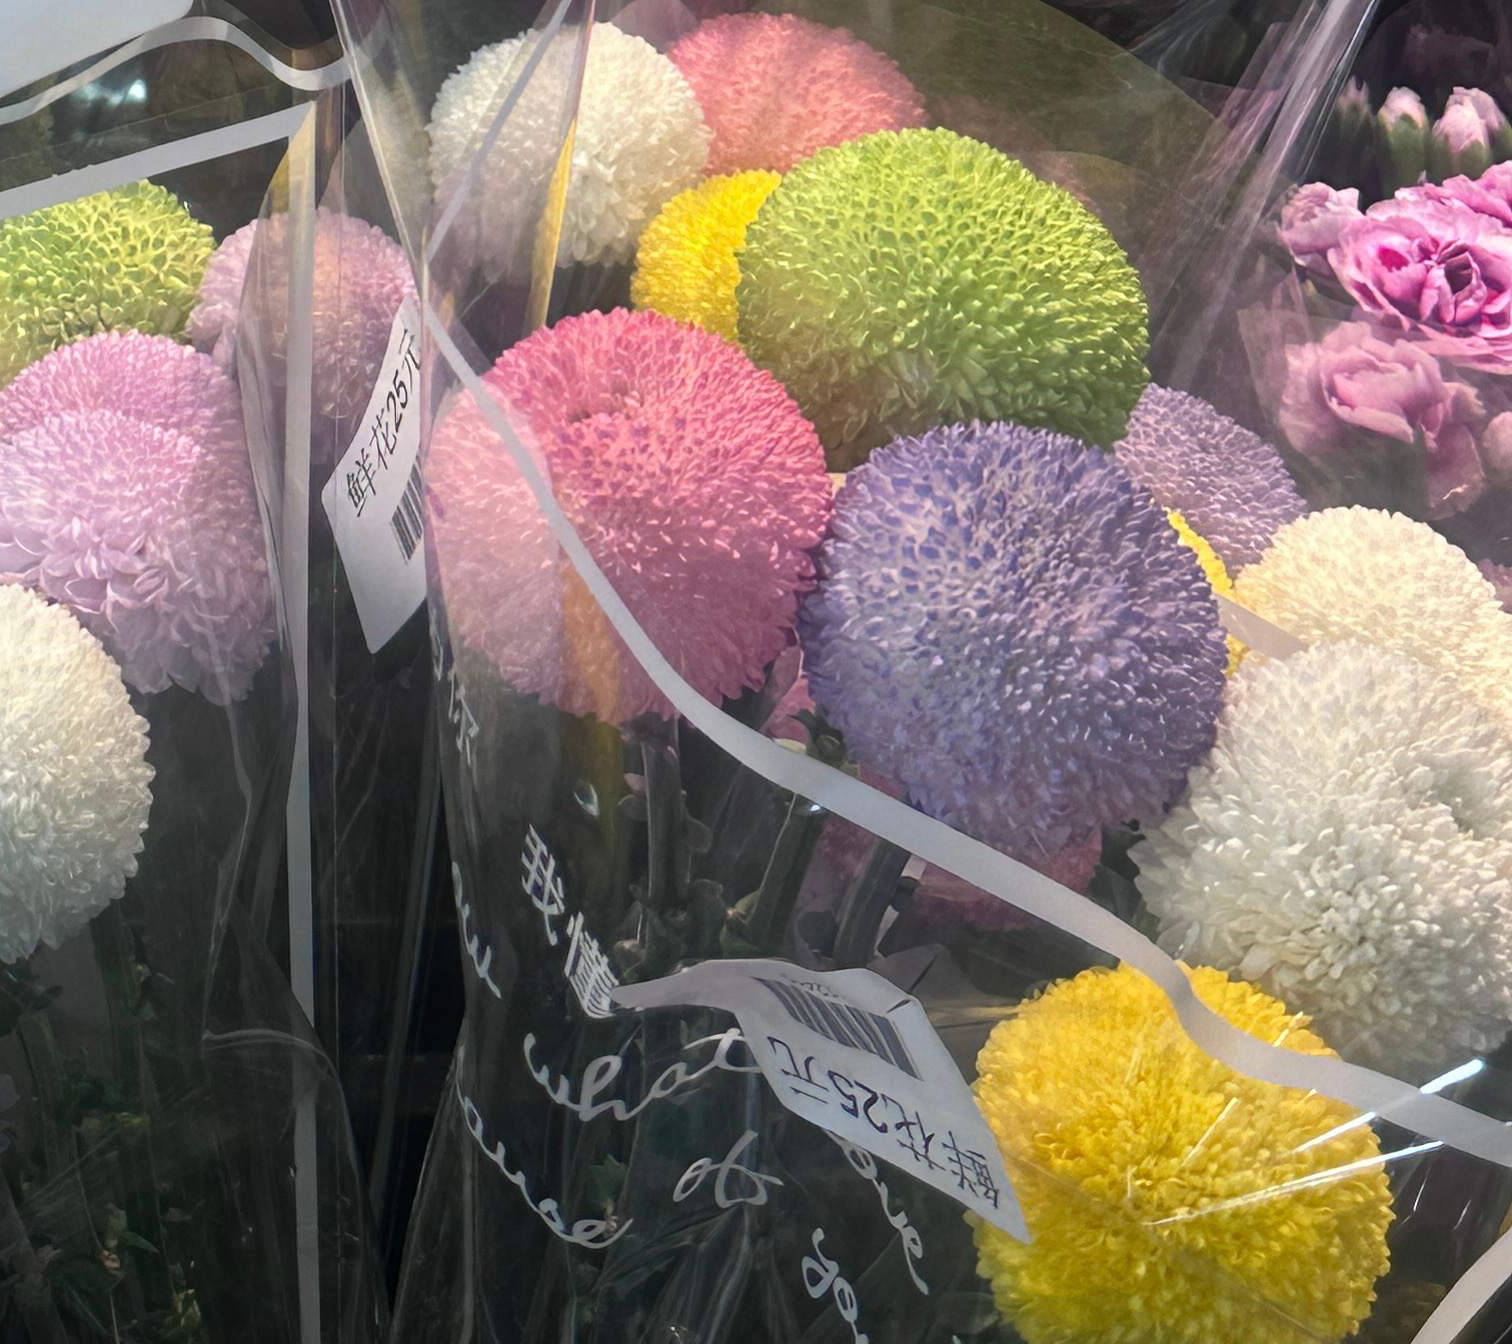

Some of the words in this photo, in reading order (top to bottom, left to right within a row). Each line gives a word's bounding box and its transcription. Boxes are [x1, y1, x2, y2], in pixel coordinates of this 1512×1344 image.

[346, 327, 422, 518] 鲜花25元
[766, 1035, 1001, 1210] 鲜花25元
